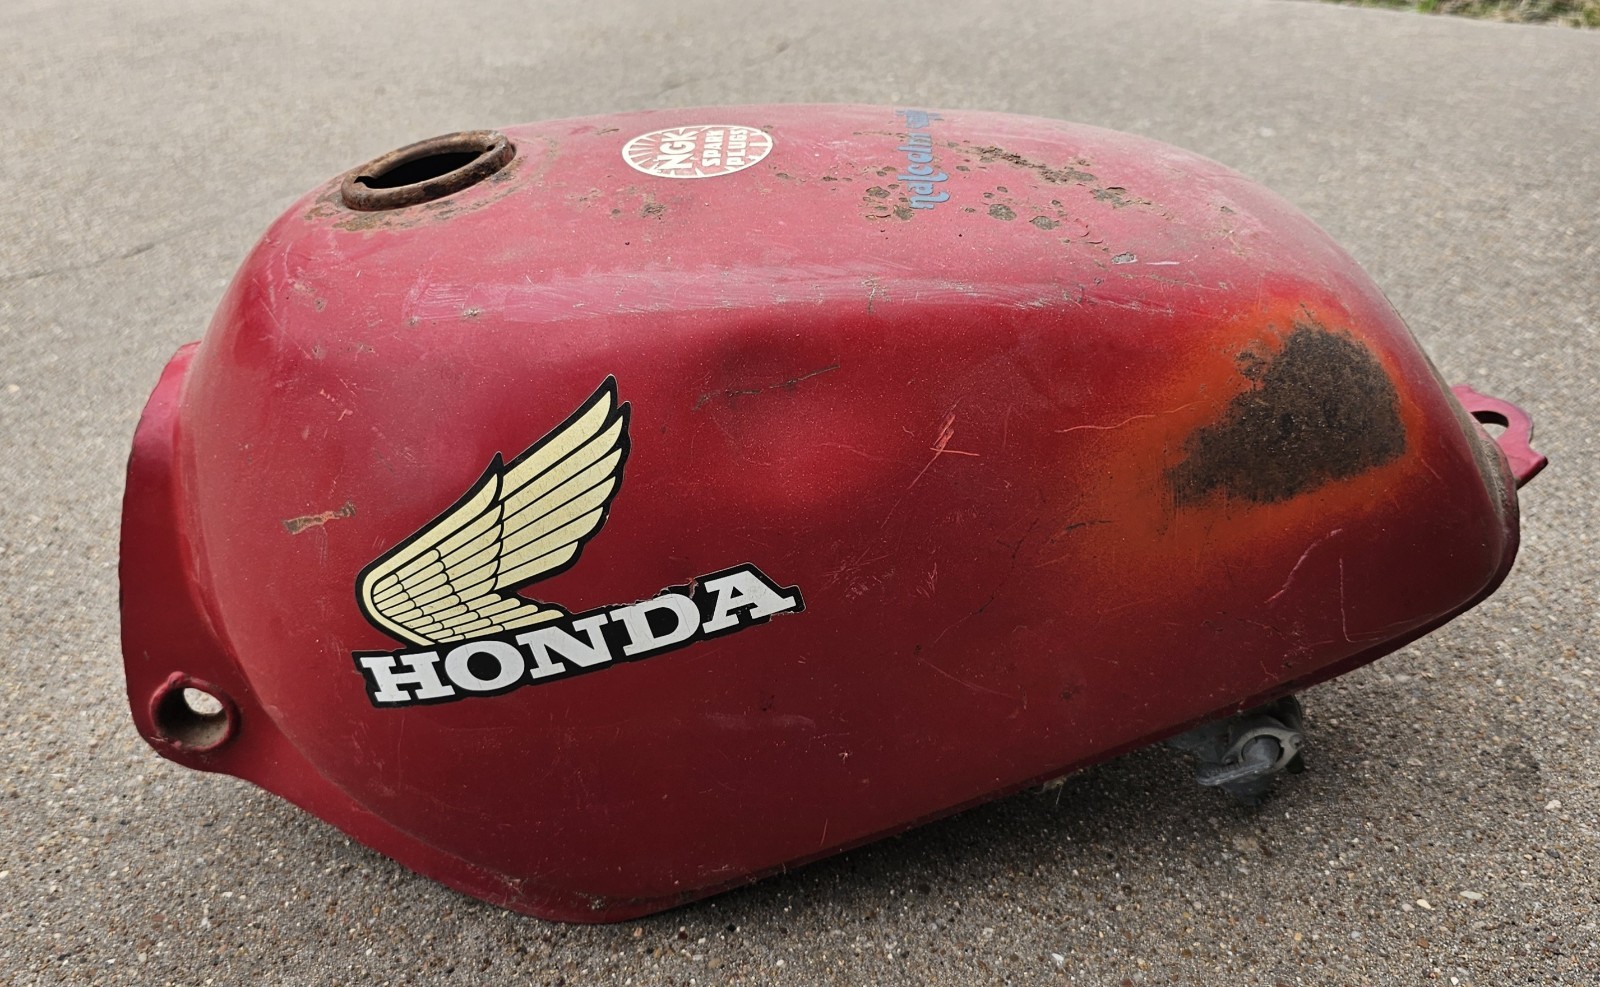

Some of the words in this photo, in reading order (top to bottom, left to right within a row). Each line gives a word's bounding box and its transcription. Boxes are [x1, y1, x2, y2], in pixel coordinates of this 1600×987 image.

[657, 130, 699, 170] NGK
[701, 129, 725, 167] SPARK
[726, 128, 748, 166] PLUGS
[360, 570, 796, 701] HONDA
